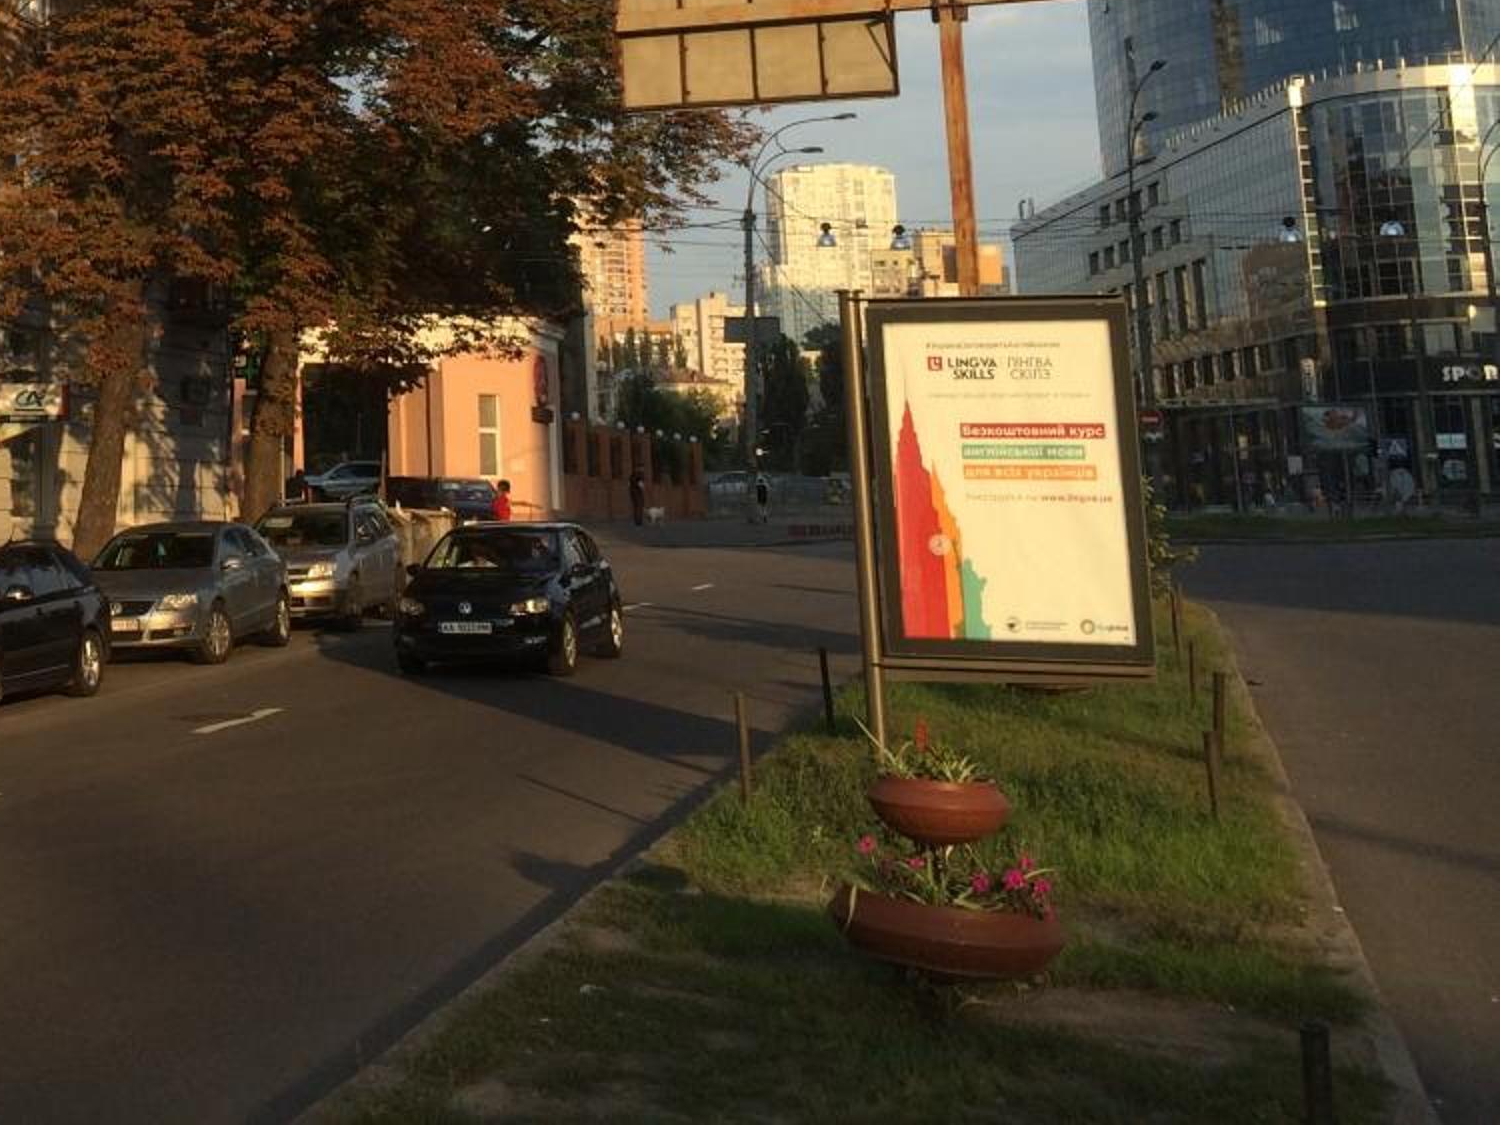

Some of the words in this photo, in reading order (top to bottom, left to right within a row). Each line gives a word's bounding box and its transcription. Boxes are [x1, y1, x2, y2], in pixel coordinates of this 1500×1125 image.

[947, 356, 997, 368] LINGVA
[952, 368, 995, 379] SKILLS
[1069, 427, 1104, 439] курс
